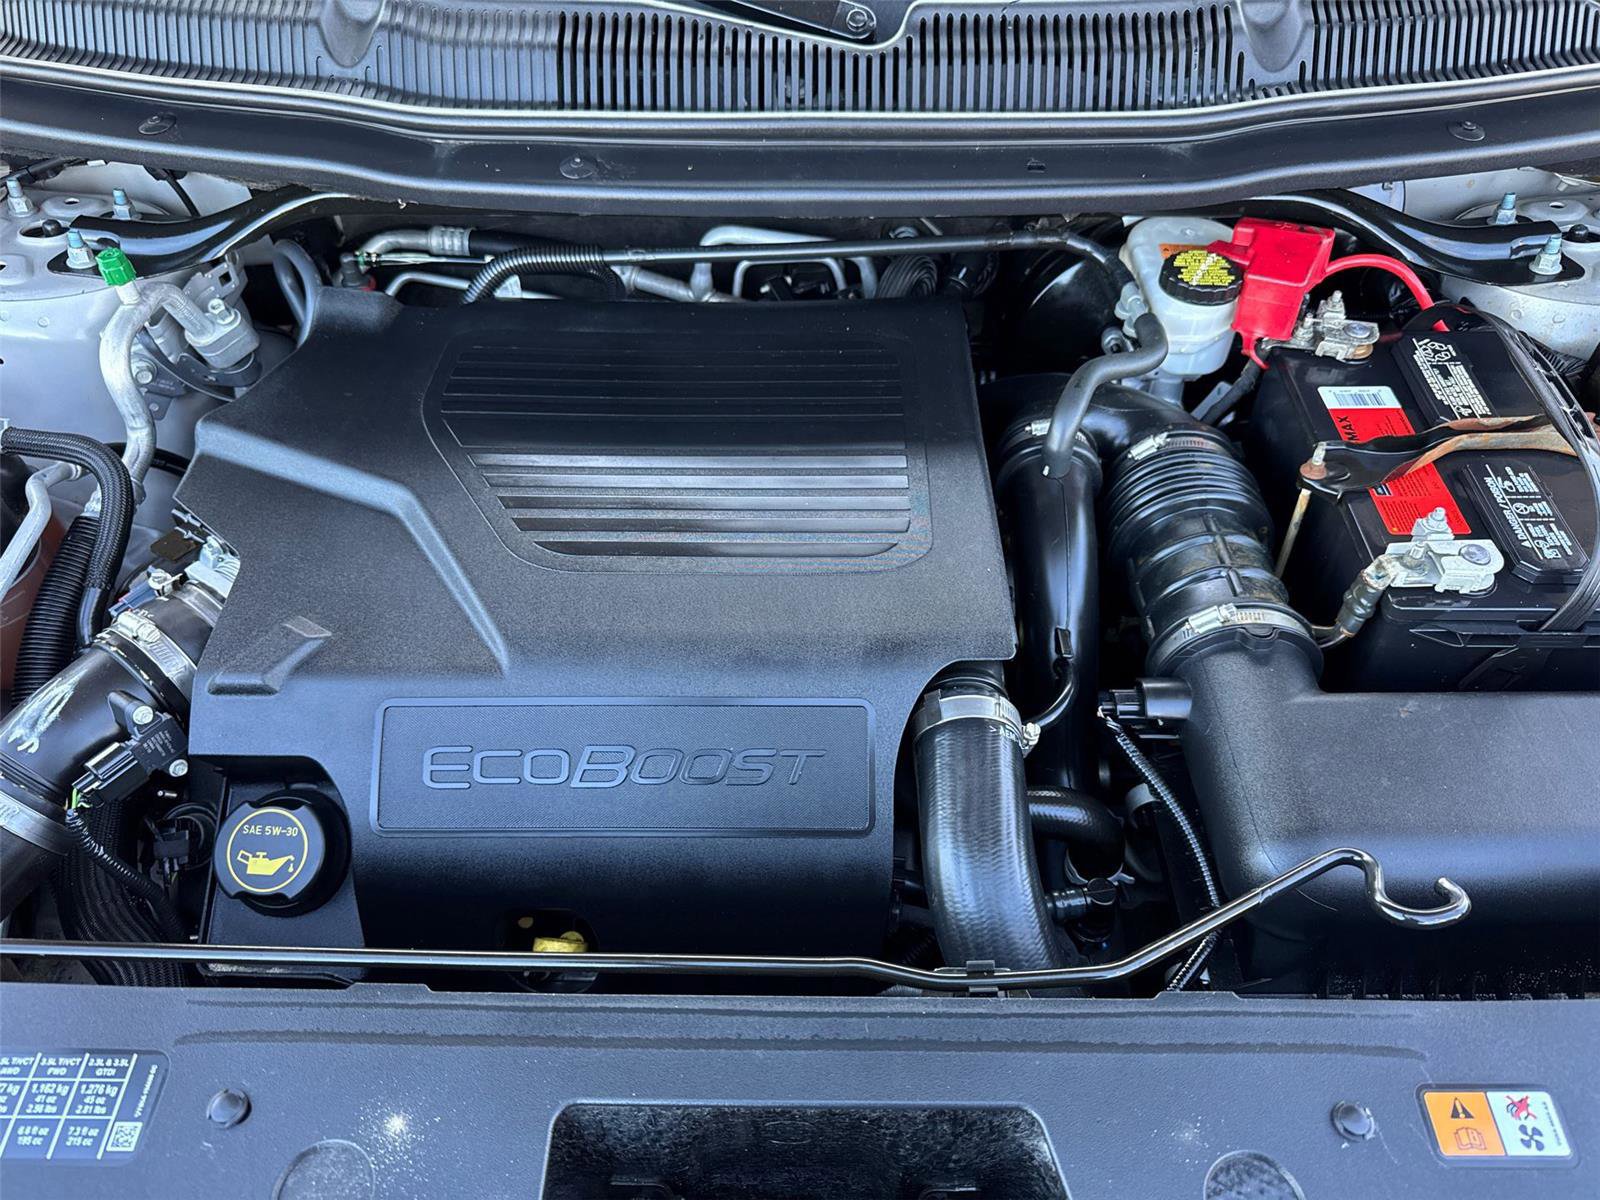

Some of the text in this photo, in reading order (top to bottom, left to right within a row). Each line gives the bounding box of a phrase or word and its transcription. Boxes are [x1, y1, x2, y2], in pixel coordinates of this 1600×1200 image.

[1337, 416, 1360, 440] MAX
[1484, 476, 1506, 503] POISON
[1502, 509, 1528, 540] DANGER
[242, 825, 299, 837] SAE 5W-30
[56, 1084, 70, 1097] kg
[105, 1084, 119, 1097] kg
